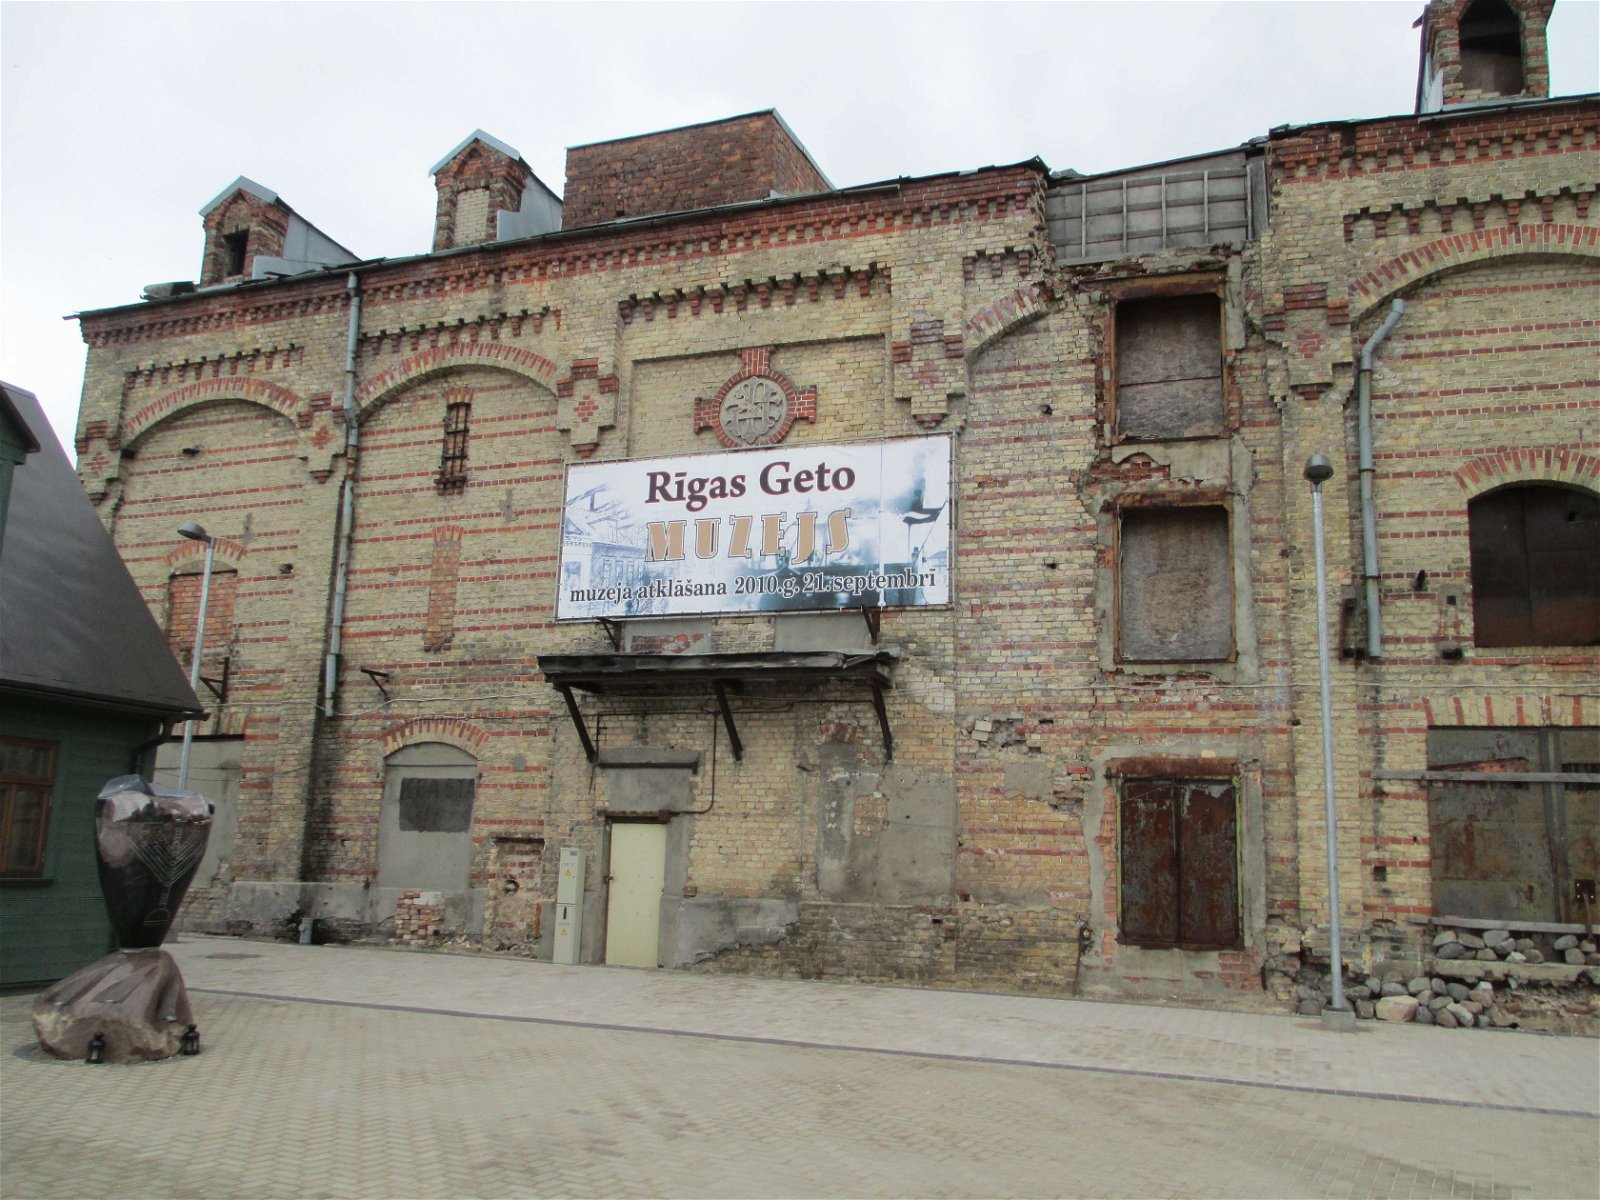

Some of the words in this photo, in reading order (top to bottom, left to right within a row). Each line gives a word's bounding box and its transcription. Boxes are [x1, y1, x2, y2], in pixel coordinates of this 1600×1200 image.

[645, 471, 746, 512] Rīgas
[759, 461, 856, 495] Geto
[645, 508, 851, 565] MUZEJS
[570, 582, 632, 604] muzeja
[637, 579, 727, 600] atklāšana
